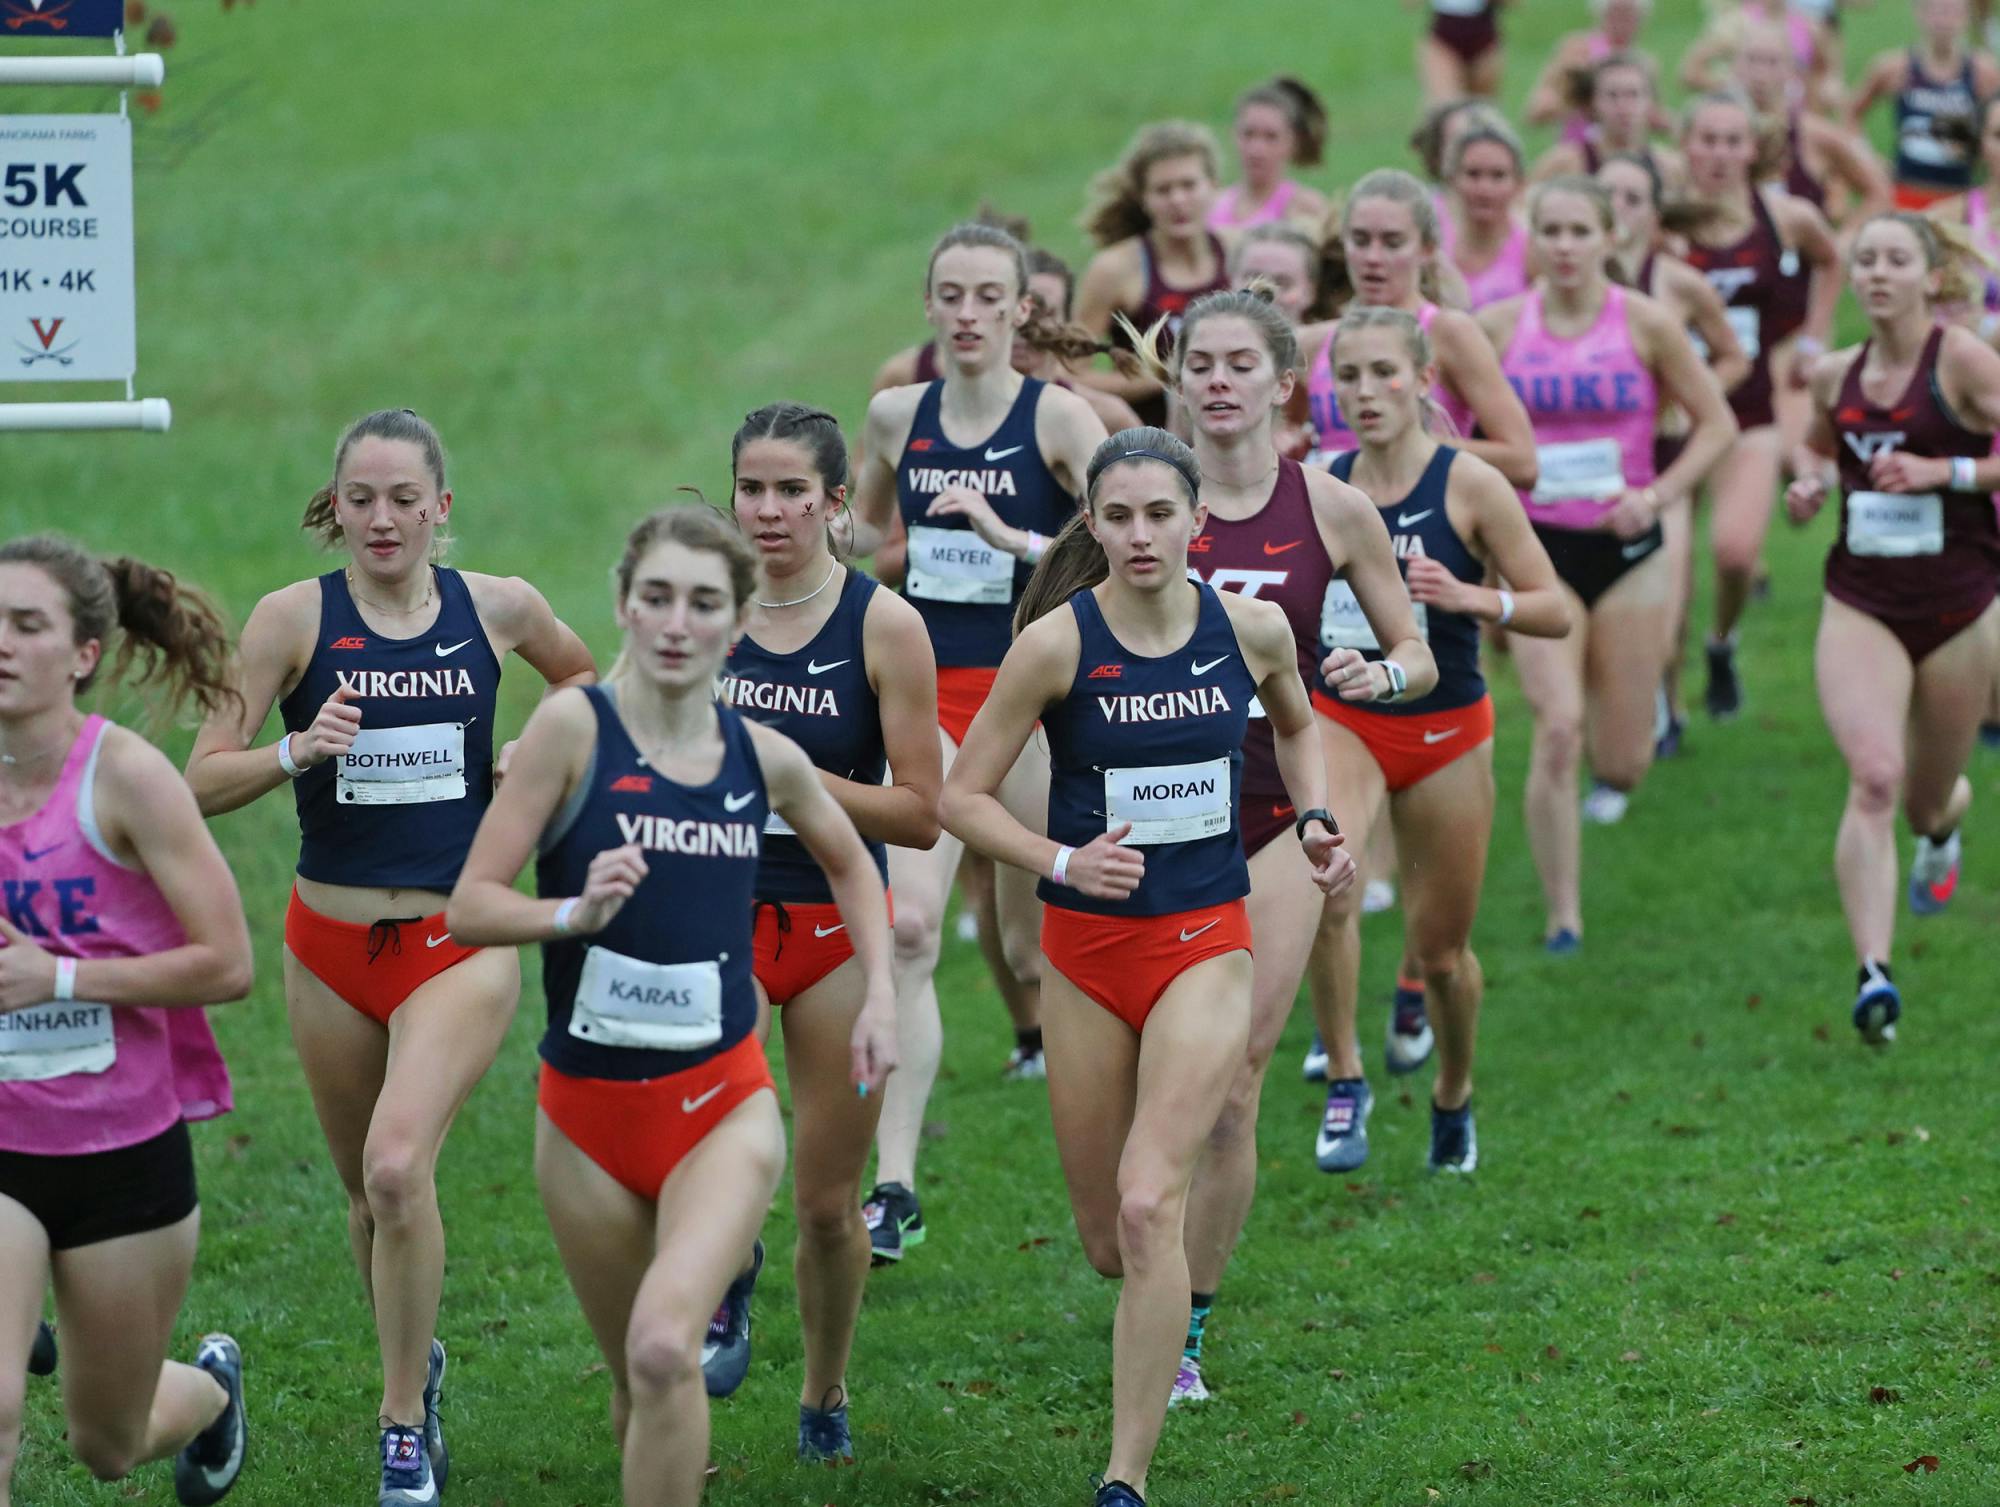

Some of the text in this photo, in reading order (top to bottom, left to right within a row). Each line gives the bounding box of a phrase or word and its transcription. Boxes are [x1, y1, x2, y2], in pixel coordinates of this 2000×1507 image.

[4, 164, 88, 207] 5K
[60, 270, 95, 292] 4K
[909, 468, 1017, 496] VIRGINIA
[931, 547, 992, 566] MEYER
[330, 637, 368, 649] ACC
[336, 669, 476, 698] VIRGINIA
[1088, 664, 1123, 678] ACC
[713, 675, 840, 717] VIRGINIA
[1097, 686, 1232, 724] VIRGINIA
[345, 750, 453, 768] BOTHWELL
[1133, 779, 1215, 801] MORAN
[616, 813, 759, 857] VIRGINIA
[609, 979, 692, 1006] KARAS
